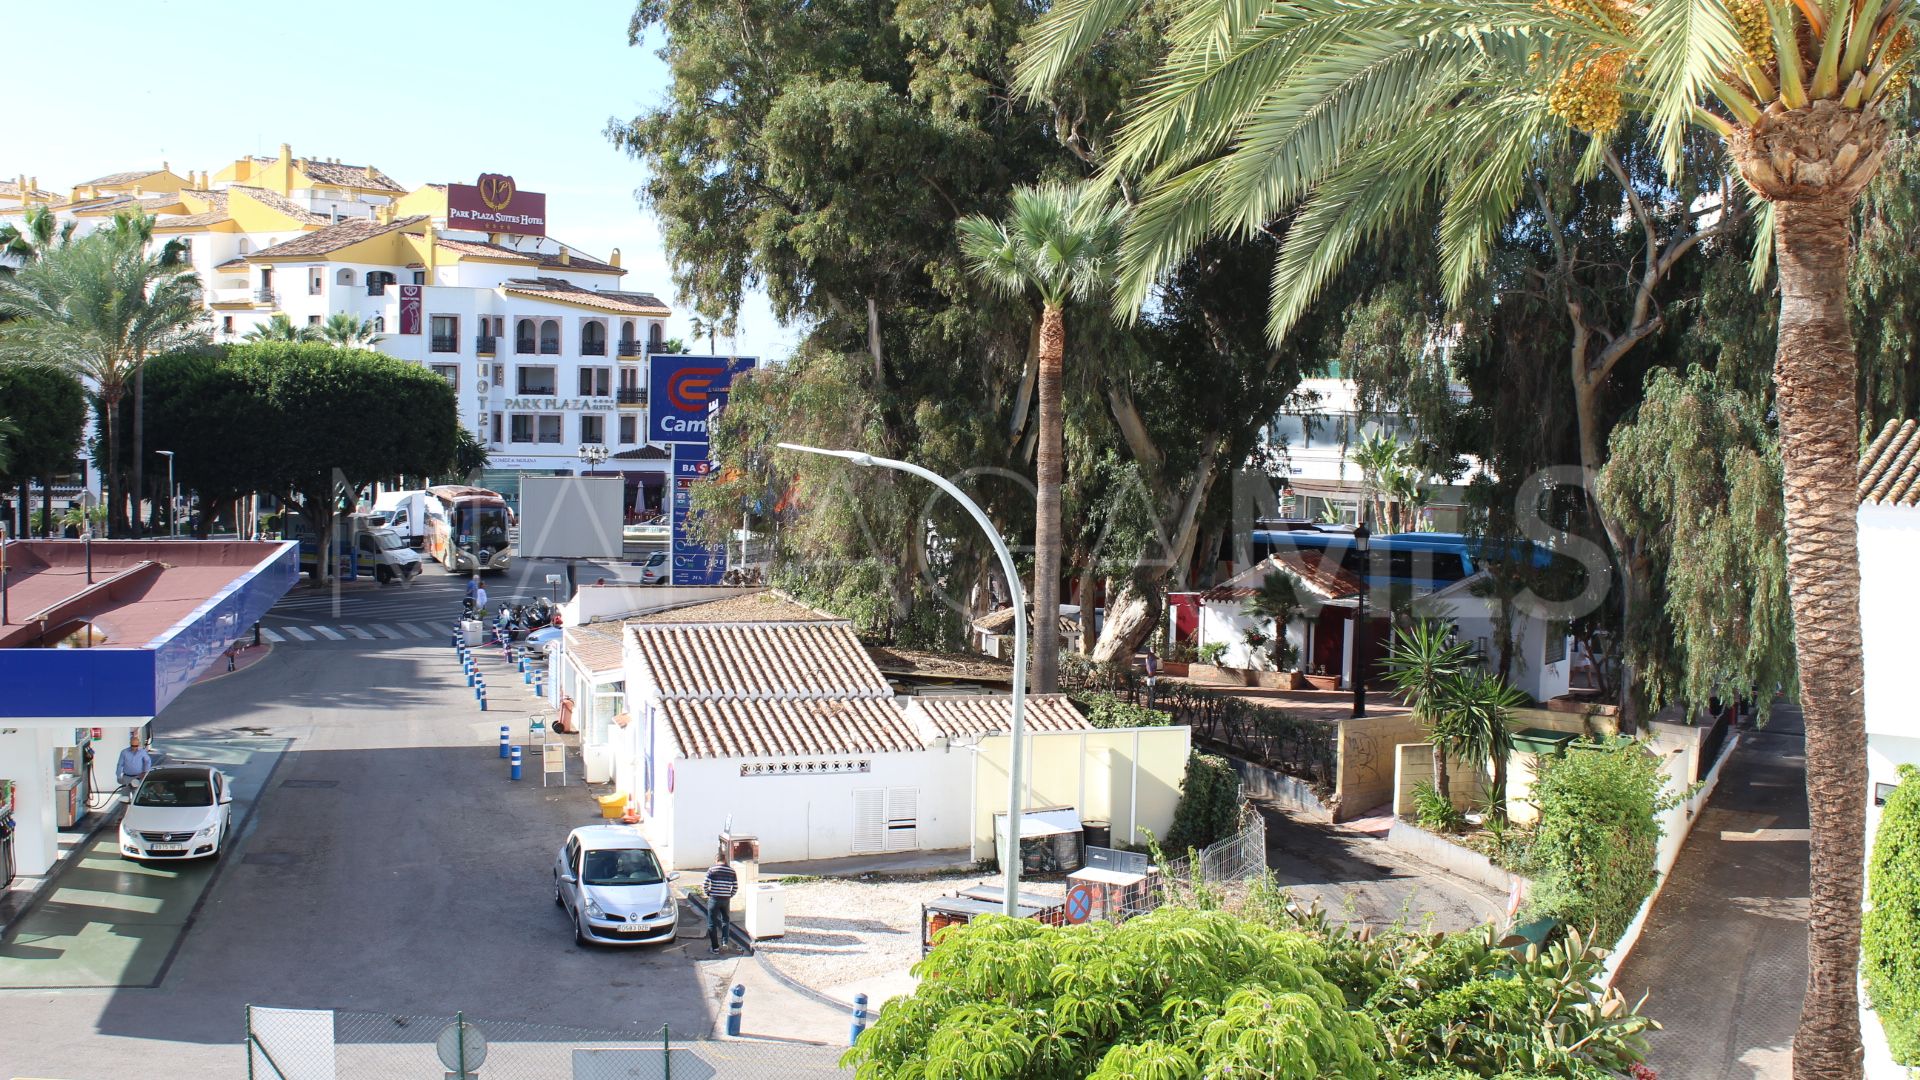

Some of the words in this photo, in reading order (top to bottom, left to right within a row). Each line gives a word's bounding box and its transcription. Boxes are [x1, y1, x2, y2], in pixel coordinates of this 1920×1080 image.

[449, 207, 469, 218] PARK
[471, 209, 495, 221] PLAZA
[495, 212, 520, 224] SUITES
[520, 214, 544, 225] HOTEL
[476, 363, 489, 443] HOTEL
[504, 398, 542, 410] PARK
[544, 398, 591, 411] PLAZA
